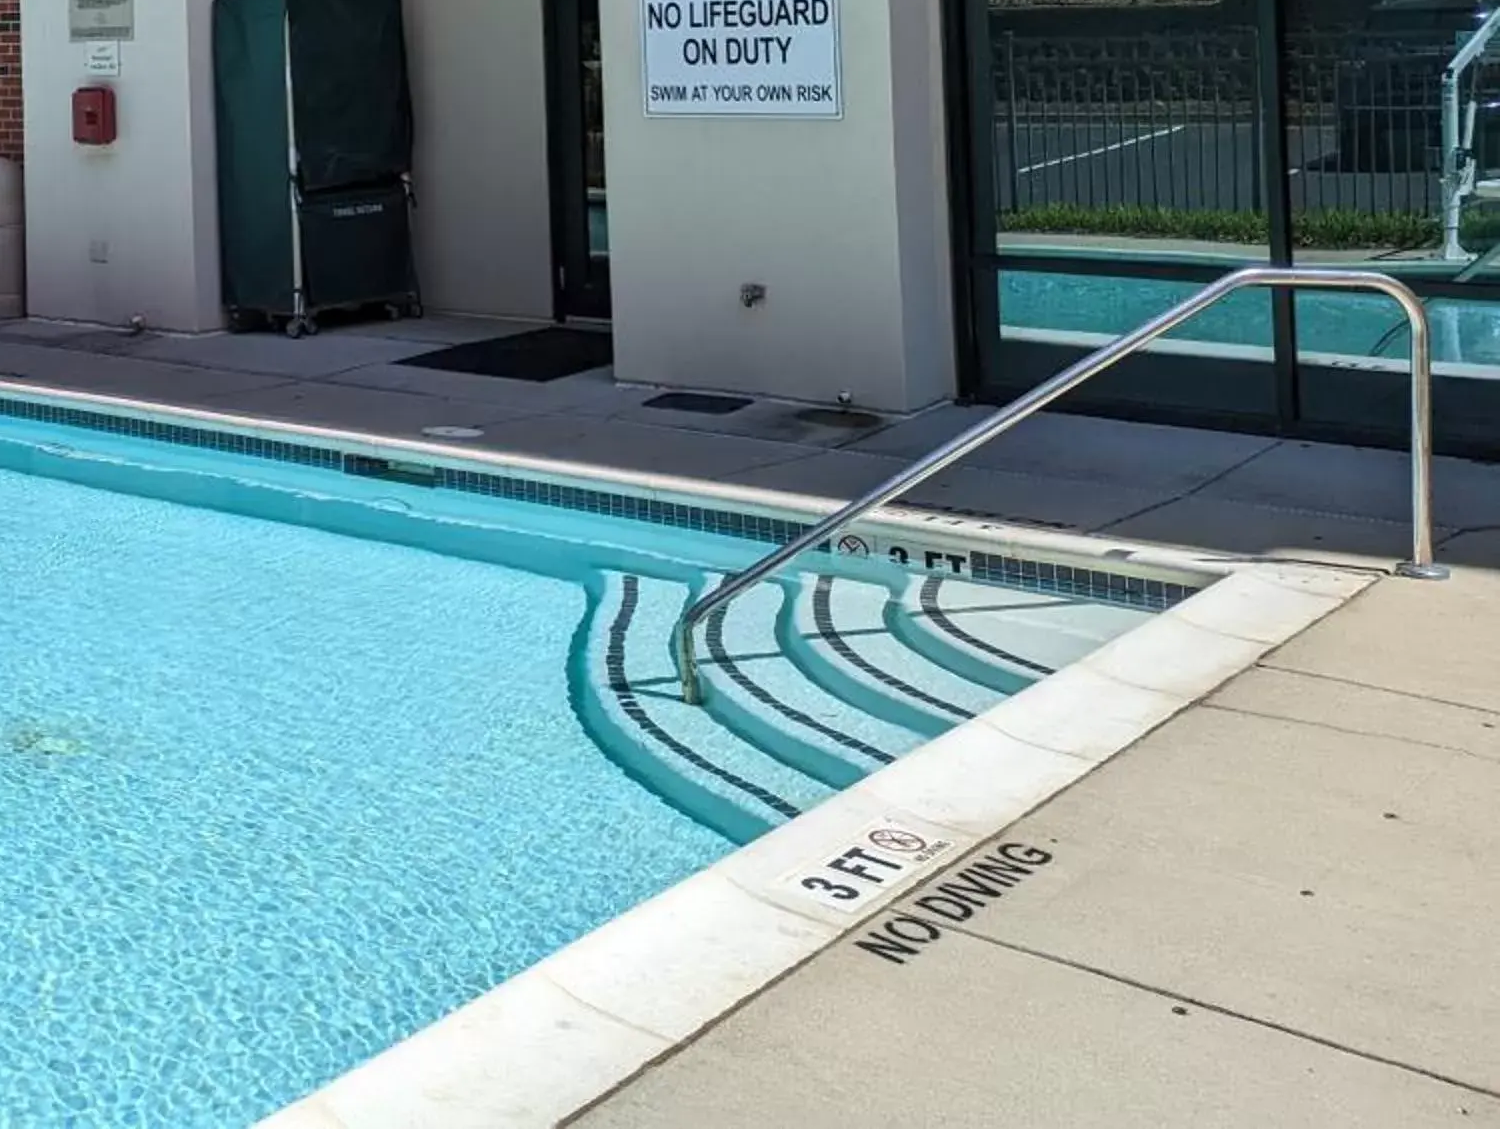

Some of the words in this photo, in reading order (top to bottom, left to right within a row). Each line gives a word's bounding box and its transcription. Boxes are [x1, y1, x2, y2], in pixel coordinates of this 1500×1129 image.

[647, 2, 681, 30] NO
[683, 38, 717, 66] ON
[726, 37, 793, 66] DUTY
[650, 86, 688, 102] SWIM
[691, 86, 708, 101] AT
[712, 85, 753, 101] YOUR
[756, 85, 792, 101] OWN
[797, 84, 833, 102] RISK
[827, 846, 903, 884] FT
[801, 876, 860, 901] 3
[853, 916, 942, 964] NO
[915, 842, 1053, 922] DIVING
